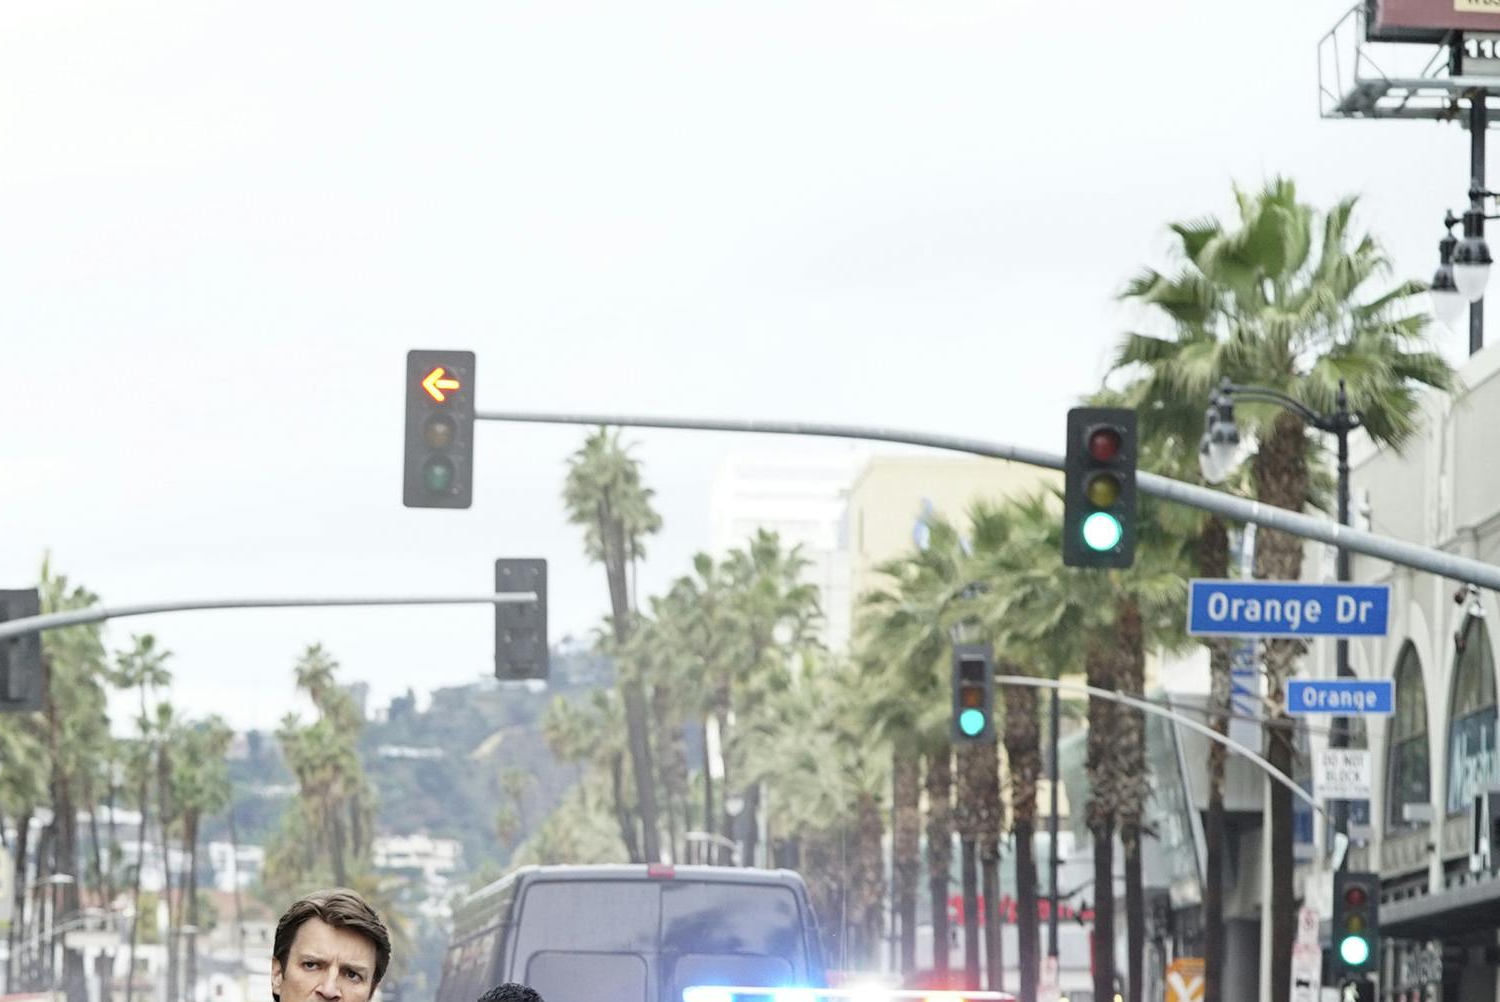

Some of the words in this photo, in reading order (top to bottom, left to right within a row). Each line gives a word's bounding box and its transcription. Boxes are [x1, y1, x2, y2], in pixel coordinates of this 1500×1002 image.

[1207, 592, 1322, 630] Orange
[1336, 594, 1373, 624] Dr
[1302, 686, 1377, 710] Orange
[1322, 753, 1339, 767] DO
[1344, 752, 1364, 768] NOT
[1326, 770, 1362, 783] BLOCK
